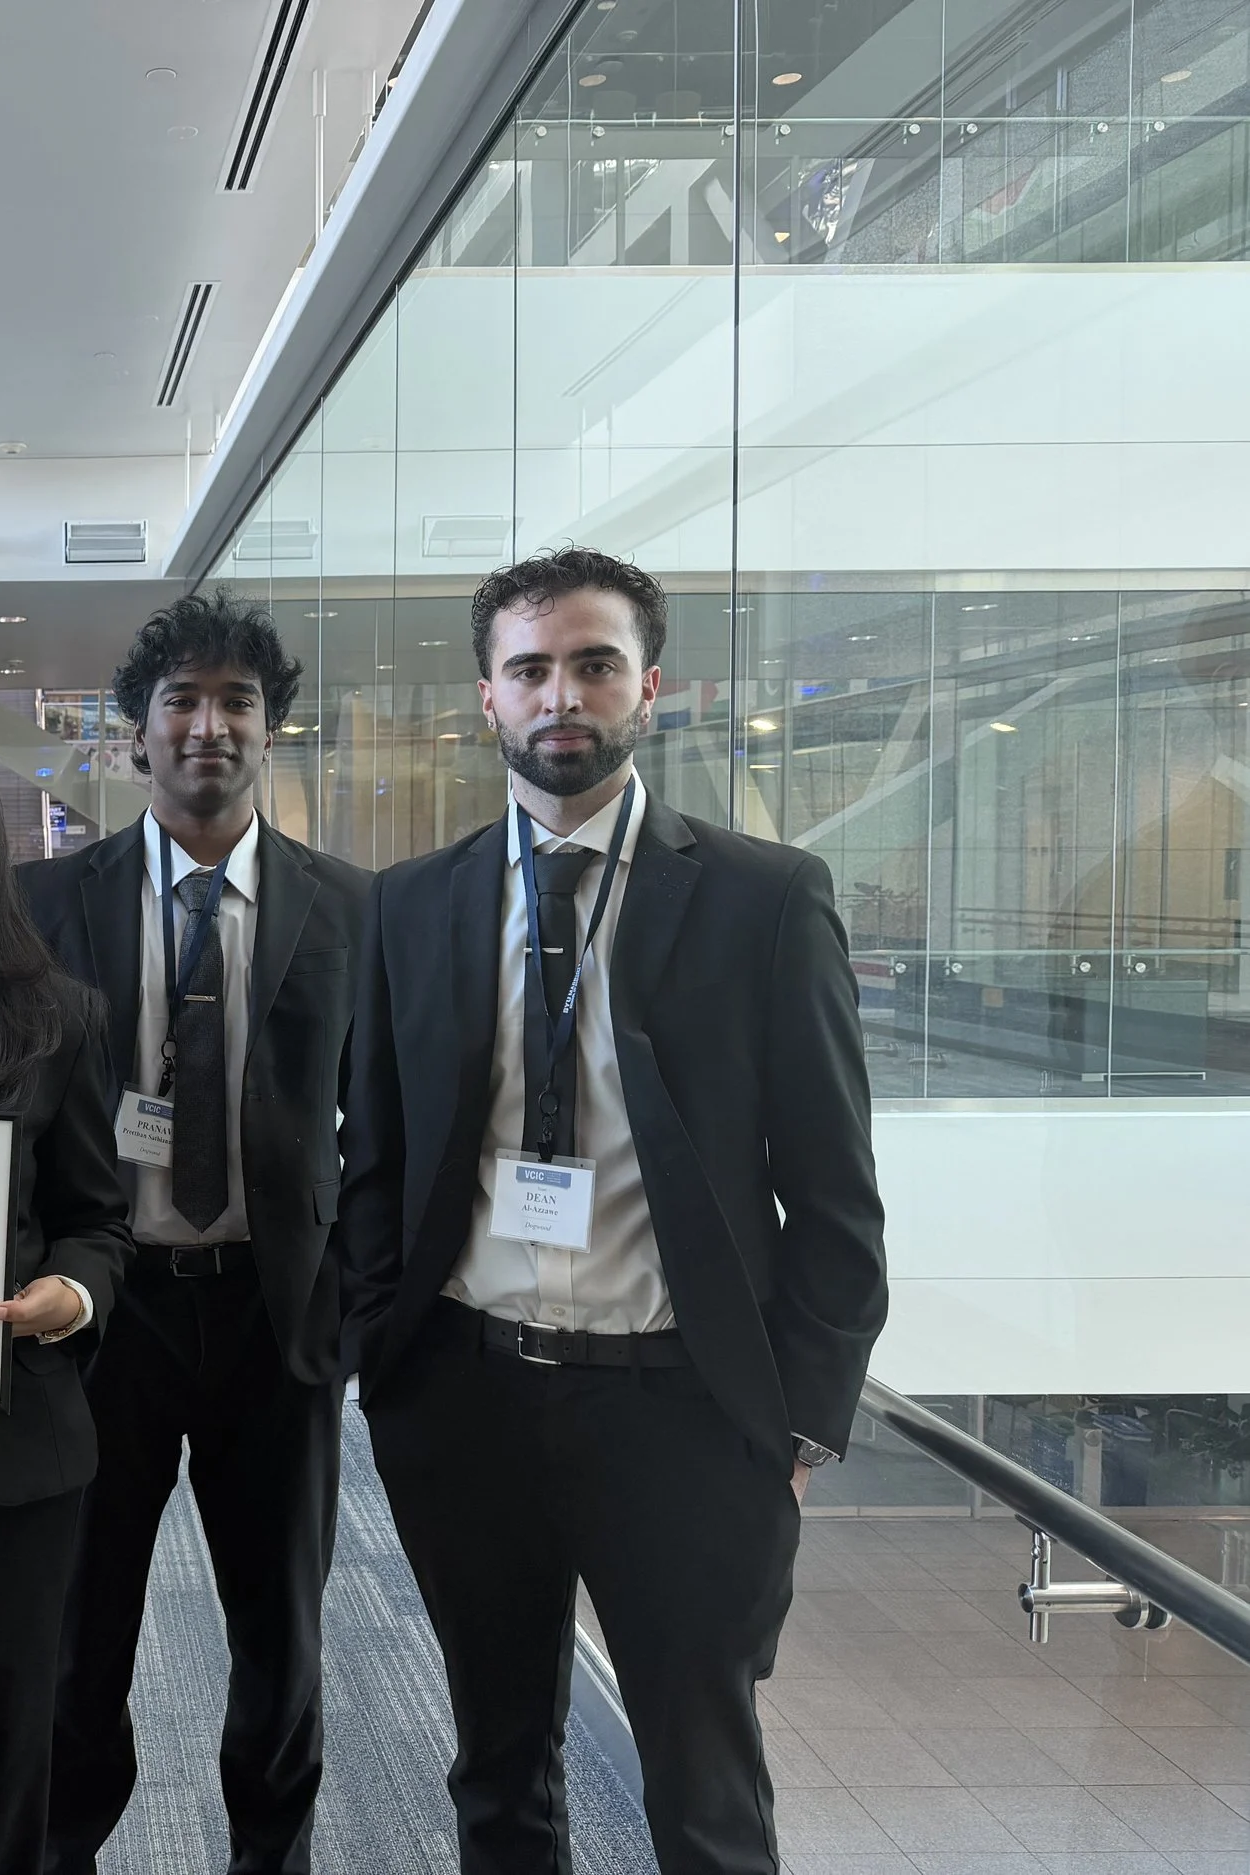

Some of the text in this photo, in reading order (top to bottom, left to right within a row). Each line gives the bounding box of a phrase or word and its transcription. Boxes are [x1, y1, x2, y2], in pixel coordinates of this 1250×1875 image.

[145, 1103, 161, 1113] VCIC
[524, 1169, 545, 1180] VCIC
[526, 1191, 557, 1205] DEAN
